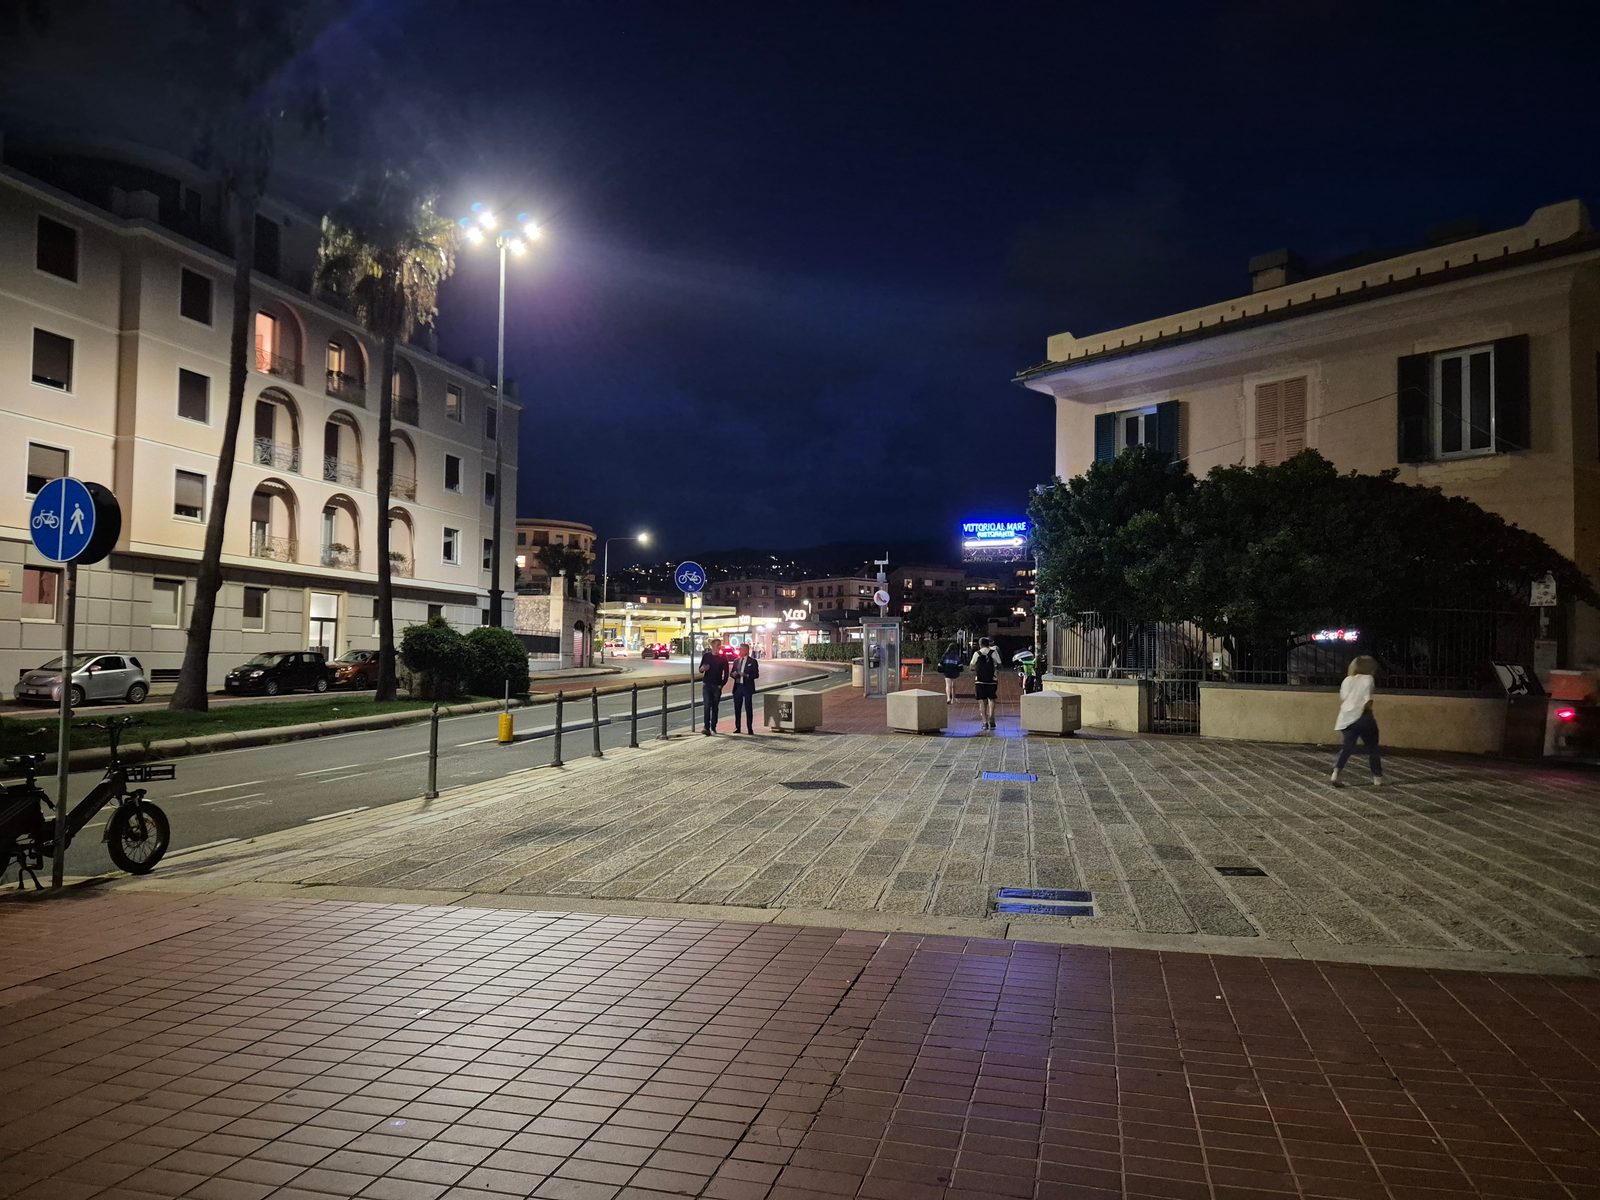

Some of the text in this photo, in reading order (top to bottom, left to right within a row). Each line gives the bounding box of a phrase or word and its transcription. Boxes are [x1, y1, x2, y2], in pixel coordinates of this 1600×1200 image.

[963, 522, 1026, 532] VITTORIO AL MARE
